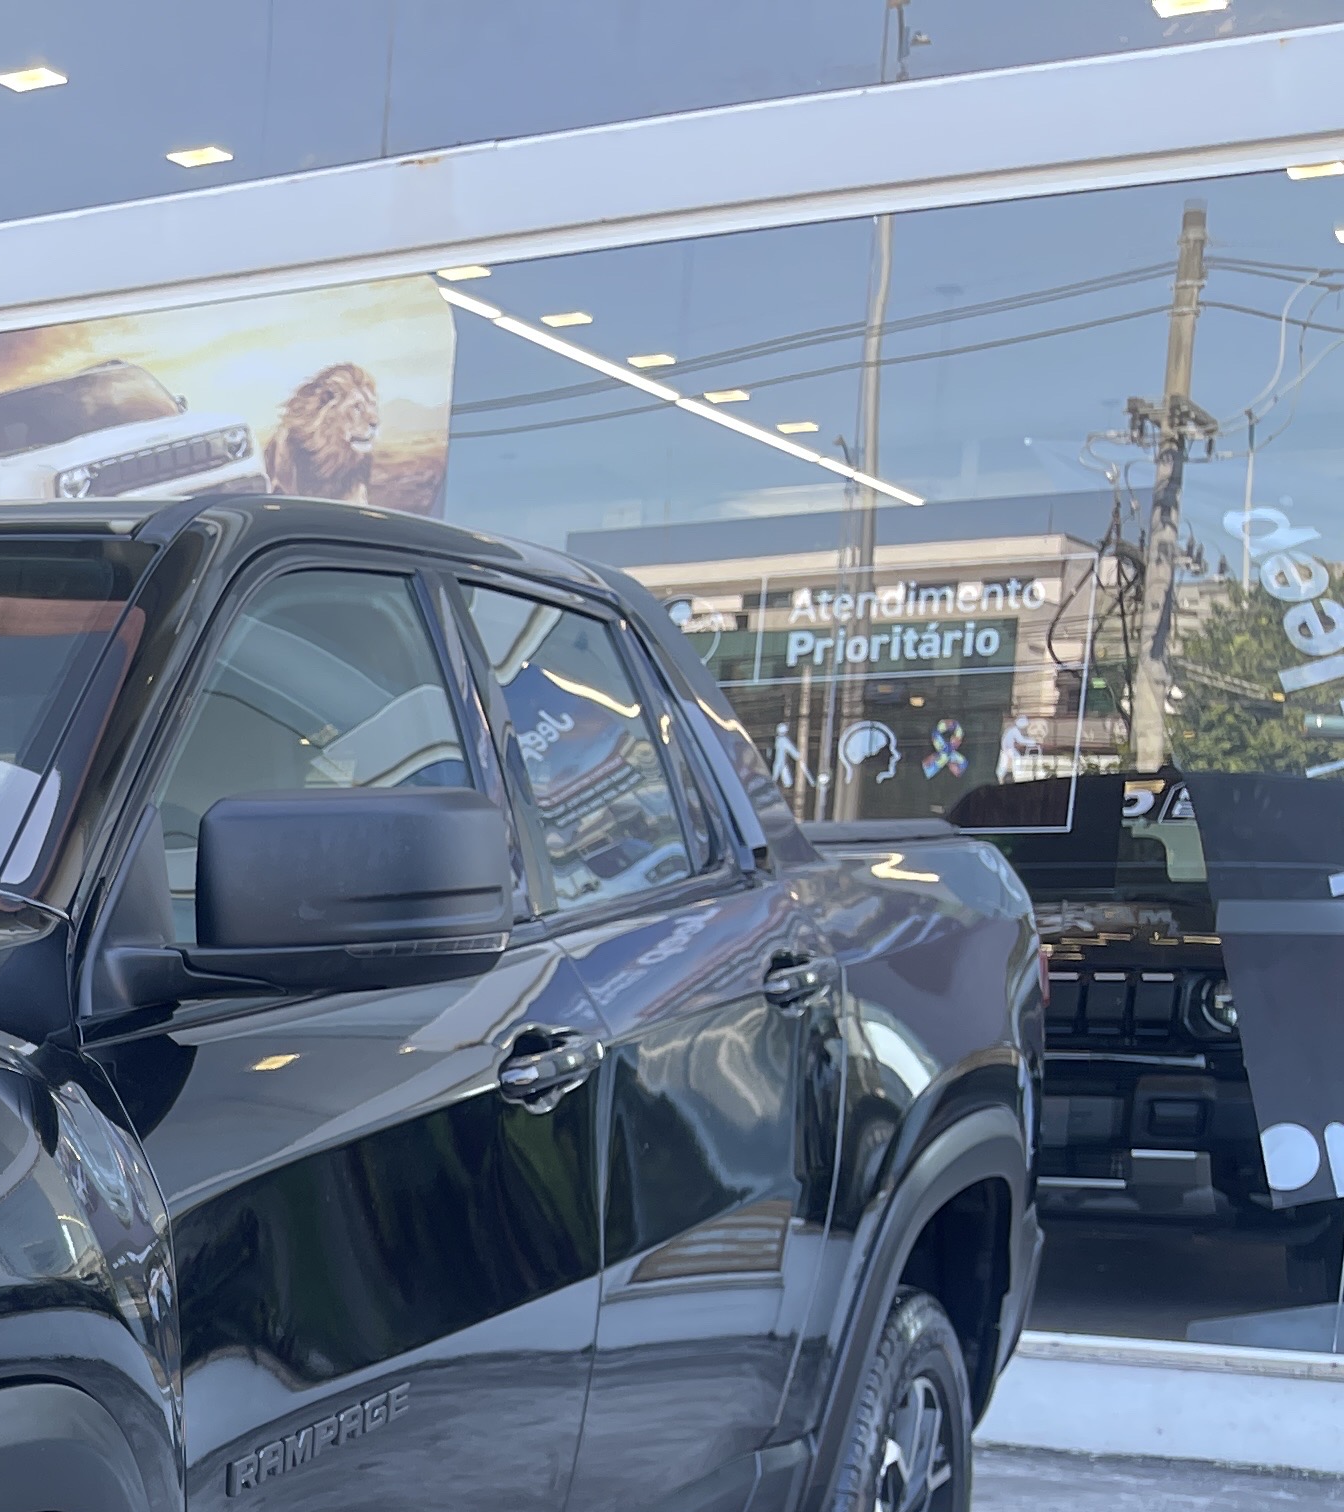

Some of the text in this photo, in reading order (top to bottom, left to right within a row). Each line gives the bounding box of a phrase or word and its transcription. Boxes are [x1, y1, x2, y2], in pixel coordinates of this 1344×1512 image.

[788, 577, 1046, 624] Atendimento
[786, 620, 1000, 668] Prioritário
[225, 1381, 411, 1498] RAMPAGE
